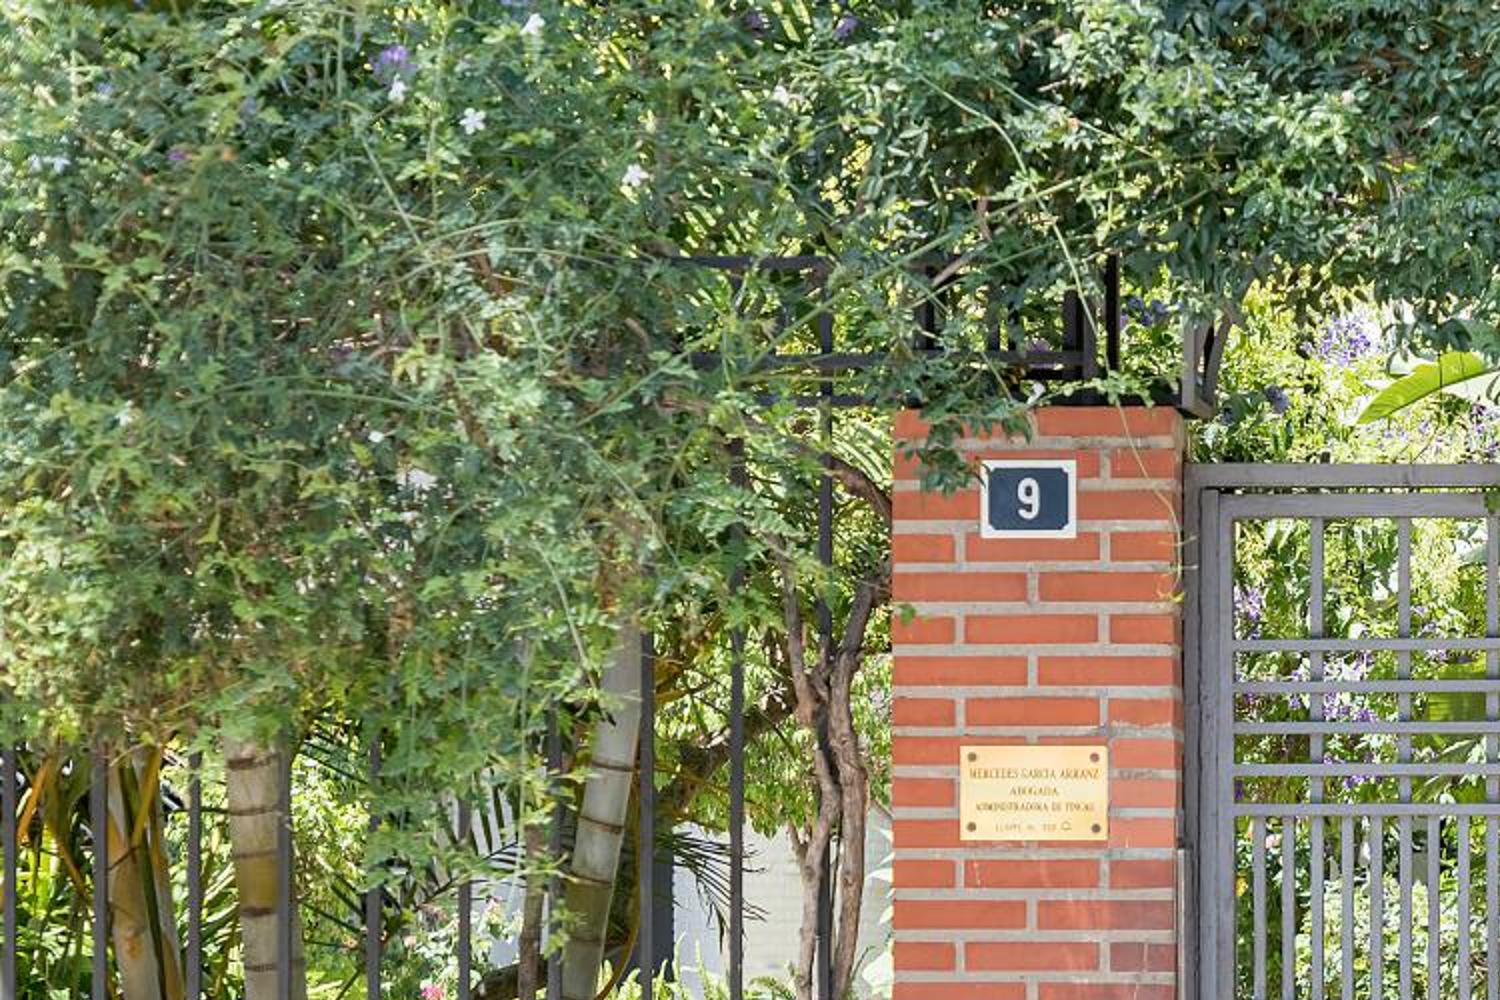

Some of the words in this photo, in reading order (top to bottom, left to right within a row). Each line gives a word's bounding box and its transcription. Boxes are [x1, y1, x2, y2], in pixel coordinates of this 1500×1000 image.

[1018, 477, 1040, 519] 9
[969, 767, 1019, 779] MERCEDES
[1059, 767, 1100, 779] ARRANZ
